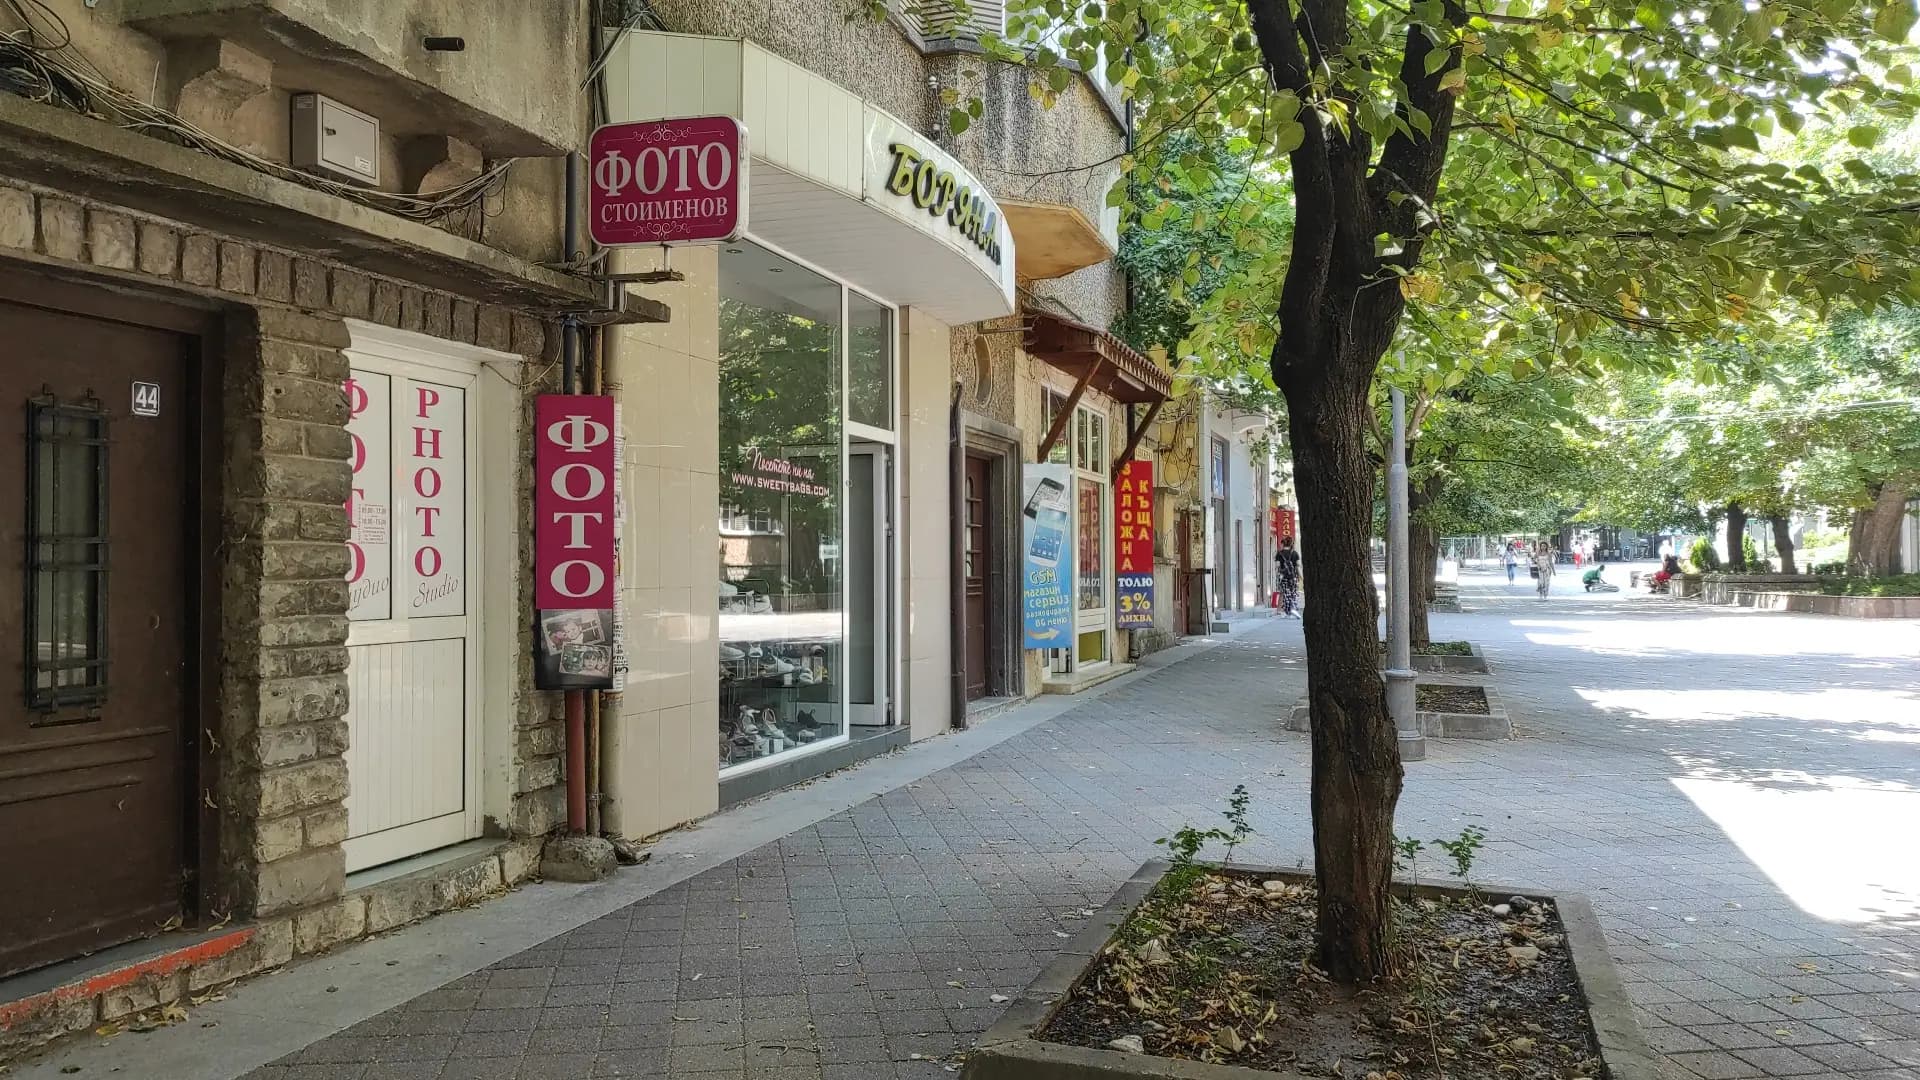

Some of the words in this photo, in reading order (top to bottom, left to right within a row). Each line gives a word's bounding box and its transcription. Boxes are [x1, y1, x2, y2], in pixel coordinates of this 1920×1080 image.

[594, 141, 731, 197] ФОТО
[601, 197, 728, 223] СТОИМЕНОВ
[886, 144, 1000, 264] БОРЯНА
[135, 385, 158, 409] 44
[412, 387, 442, 577] PHOTO
[731, 472, 830, 497] WWW.SWEETYBAGS.COM
[547, 415, 609, 598] ФОТО
[1120, 463, 1134, 571] ЗАЛОЖНА
[1137, 480, 1151, 540] КЪЩА
[1030, 568, 1058, 585] GSM
[1118, 577, 1153, 587] ТОЛЮ
[413, 573, 459, 607] Studio
[1029, 594, 1069, 608] сервиз
[1120, 592, 1150, 612] 3%
[1118, 614, 1153, 623] ЛИХВА
